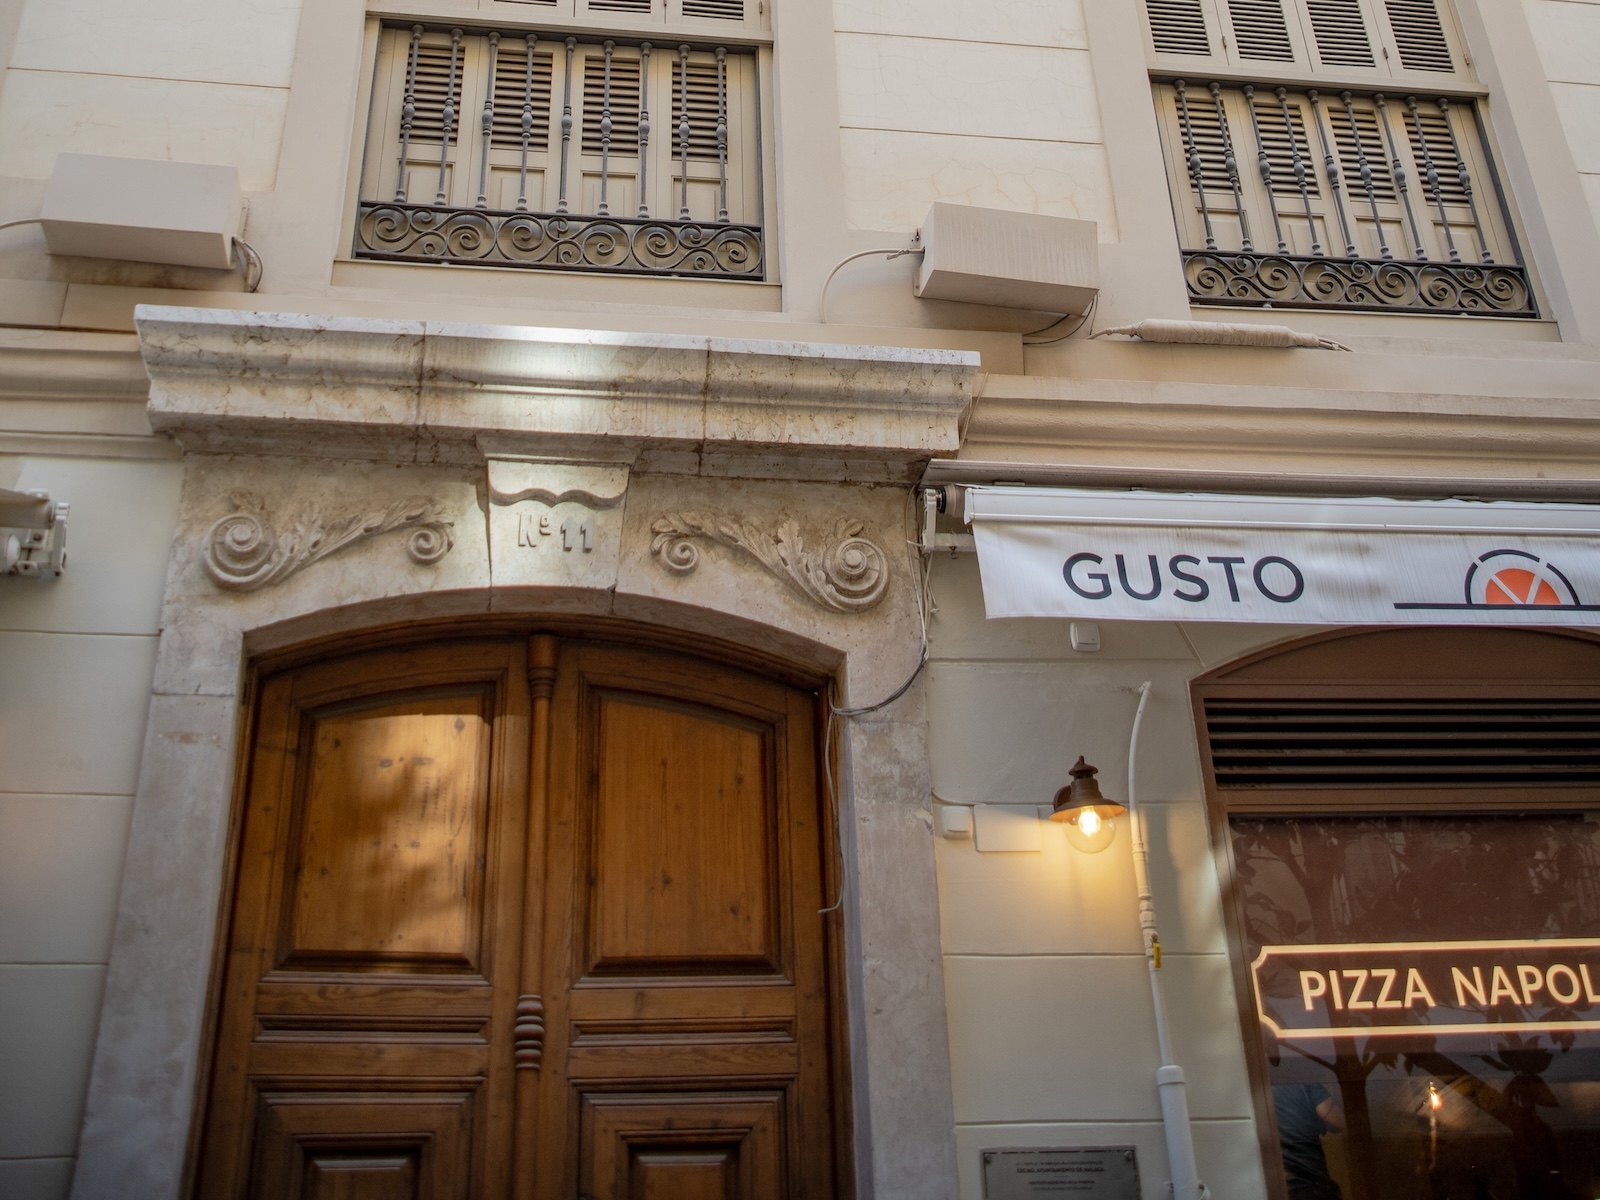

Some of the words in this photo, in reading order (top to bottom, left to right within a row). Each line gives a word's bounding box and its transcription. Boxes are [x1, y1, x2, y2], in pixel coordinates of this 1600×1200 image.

[560, 516, 593, 553] 11
[1062, 551, 1305, 604] GUSTO
[1299, 967, 1436, 1011] PIZZA
[1451, 963, 1600, 1007] NAPOL
